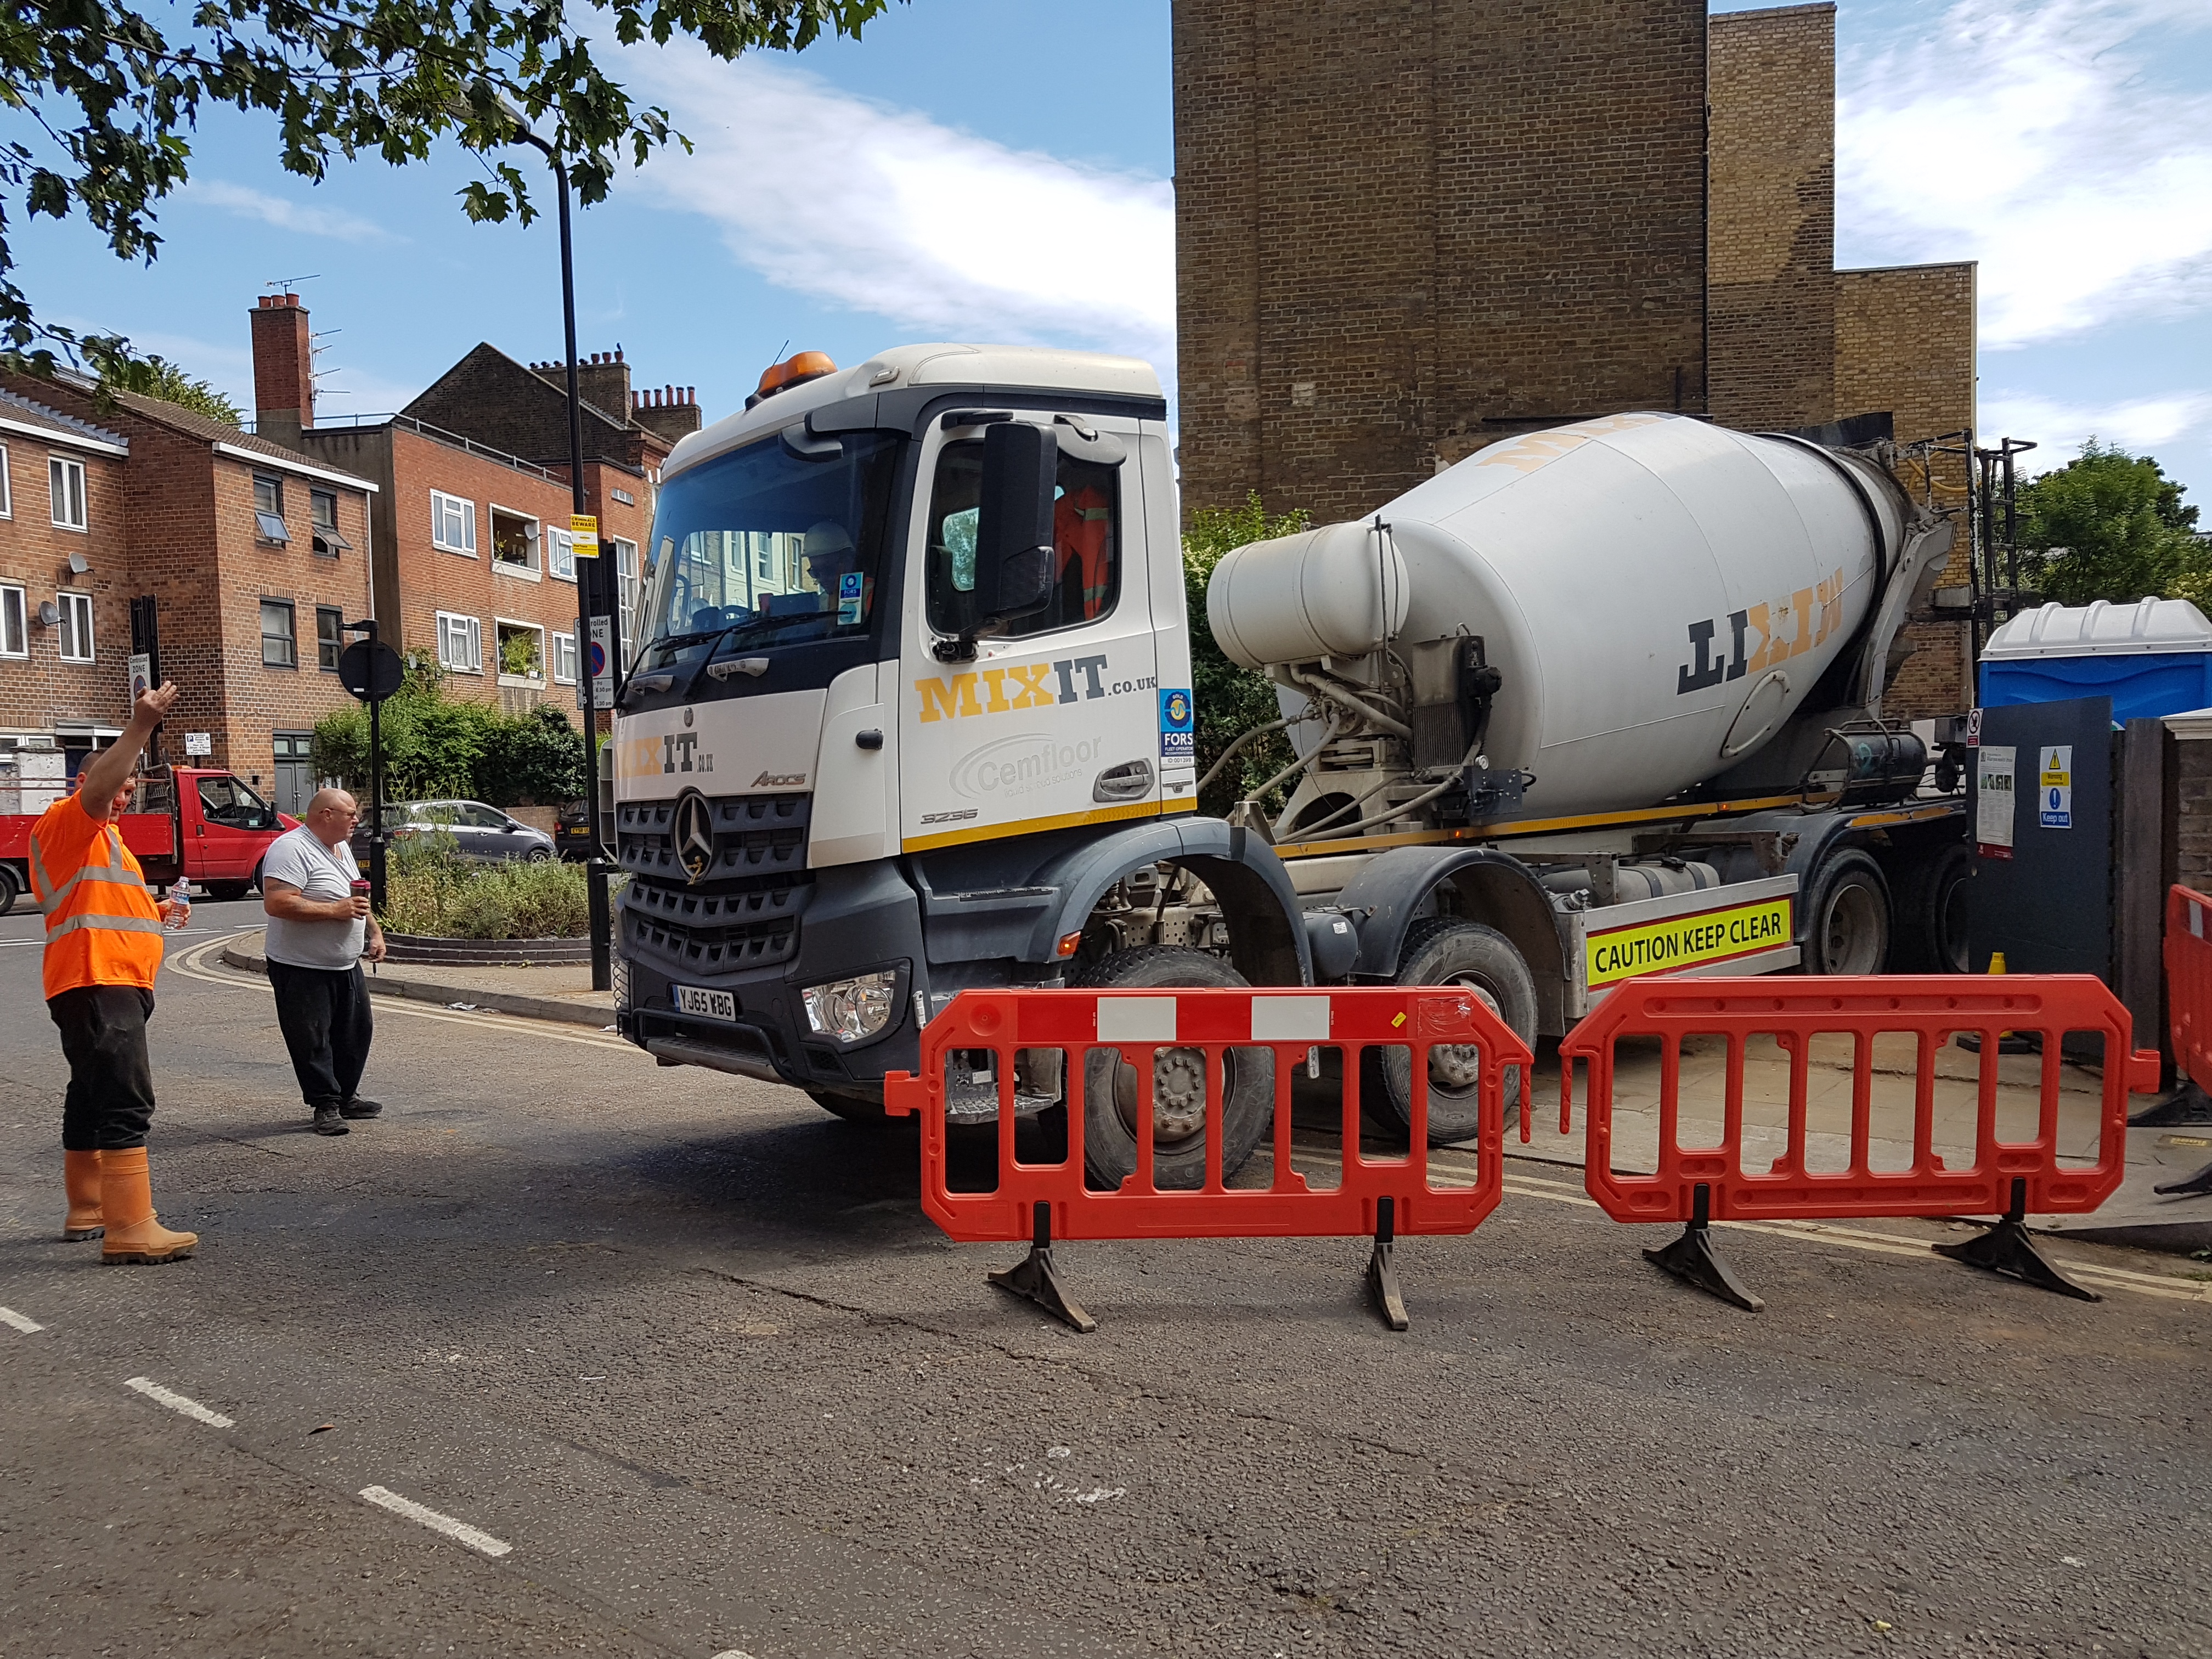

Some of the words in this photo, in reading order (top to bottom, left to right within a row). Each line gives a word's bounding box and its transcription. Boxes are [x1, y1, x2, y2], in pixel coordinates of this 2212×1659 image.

[577, 618, 608, 628] Crolled
[133, 664, 145, 673] ZONE
[1165, 733, 1193, 746] FORS
[977, 736, 1102, 792] Cemfloor
[921, 808, 979, 824] 3236
[2042, 812, 2057, 824] Keep
[2058, 814, 2068, 822] out
[1595, 933, 1678, 973] CAUTION
[1684, 923, 1725, 955] KEEP
[1730, 912, 1781, 944] CLEAR
[680, 989, 708, 1013] YJ65
